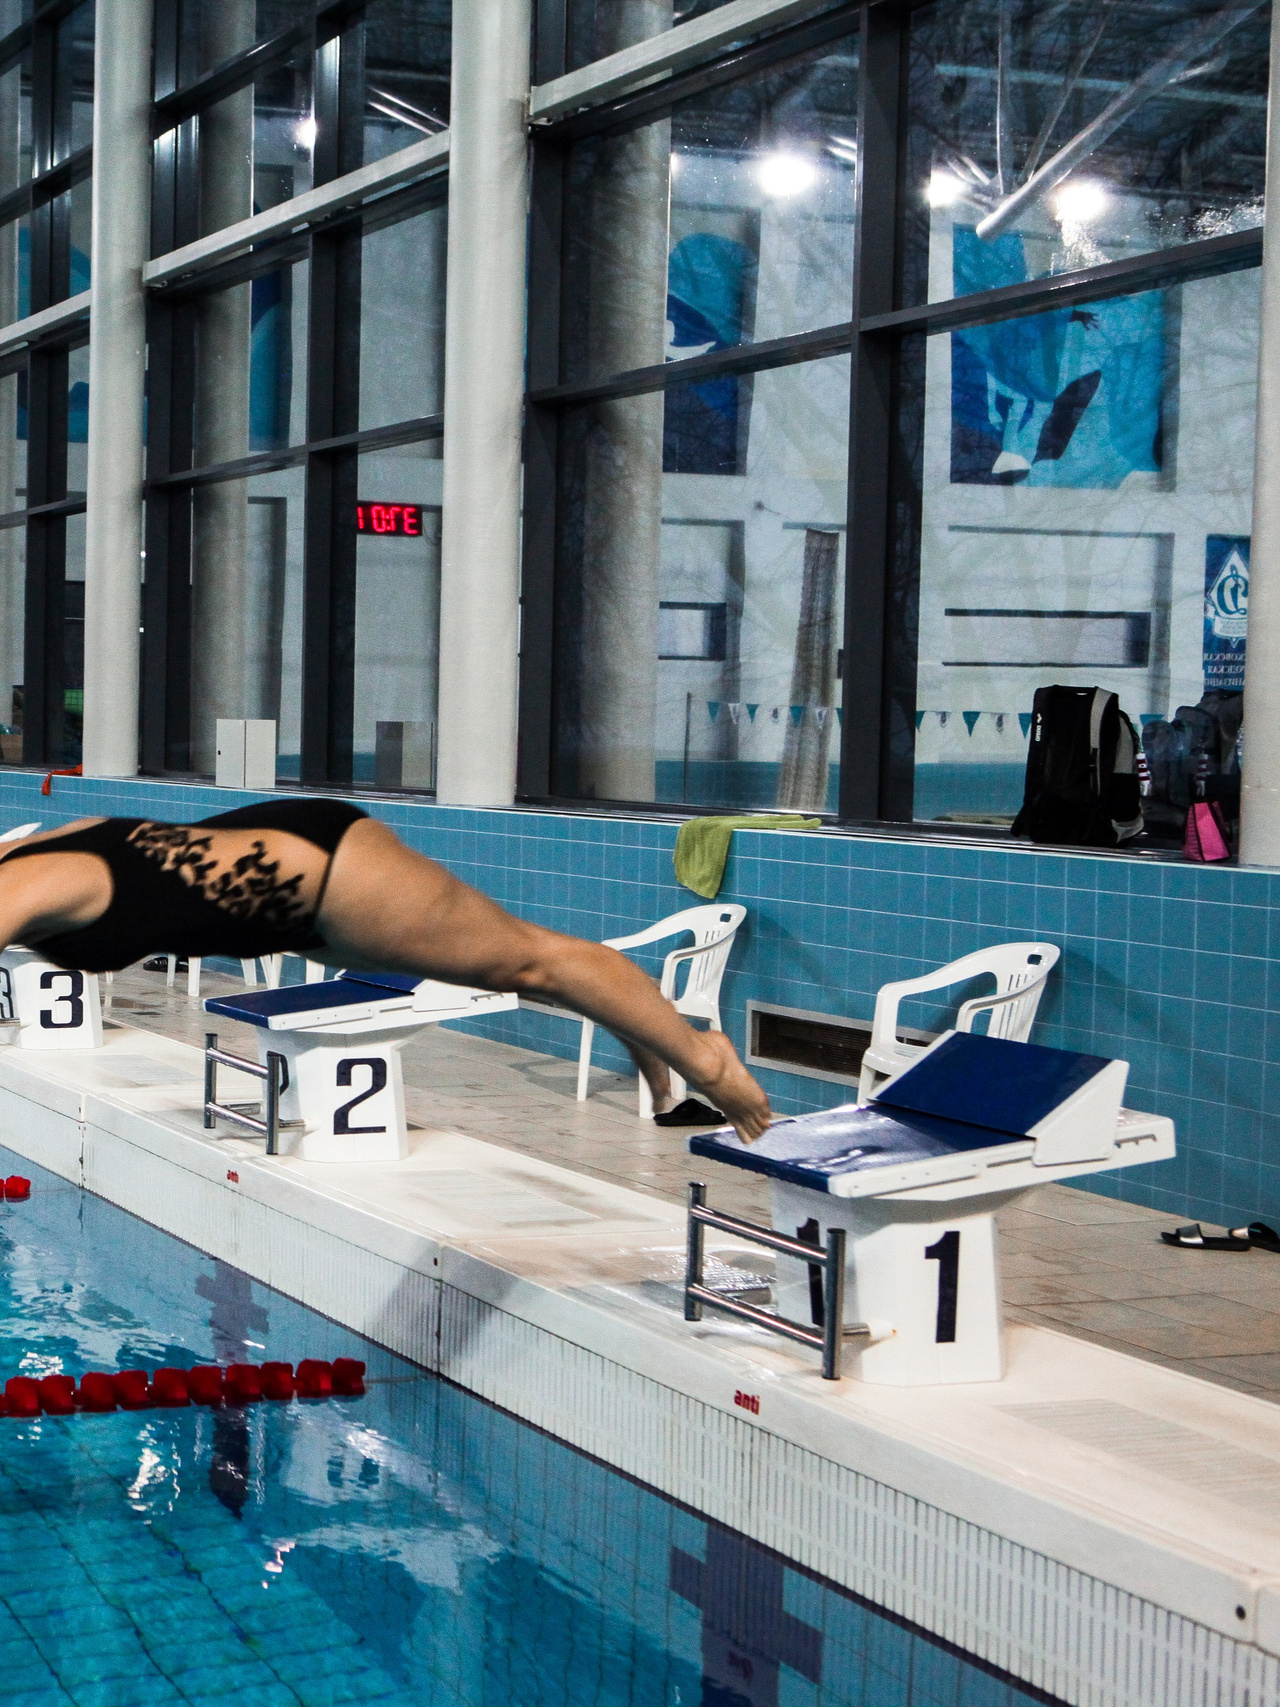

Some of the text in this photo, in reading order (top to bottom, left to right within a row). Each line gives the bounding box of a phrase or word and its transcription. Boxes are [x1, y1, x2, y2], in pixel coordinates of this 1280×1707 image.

[40, 970, 83, 1029] 3
[333, 1057, 387, 1135] 2
[924, 1230, 960, 1343] 1
